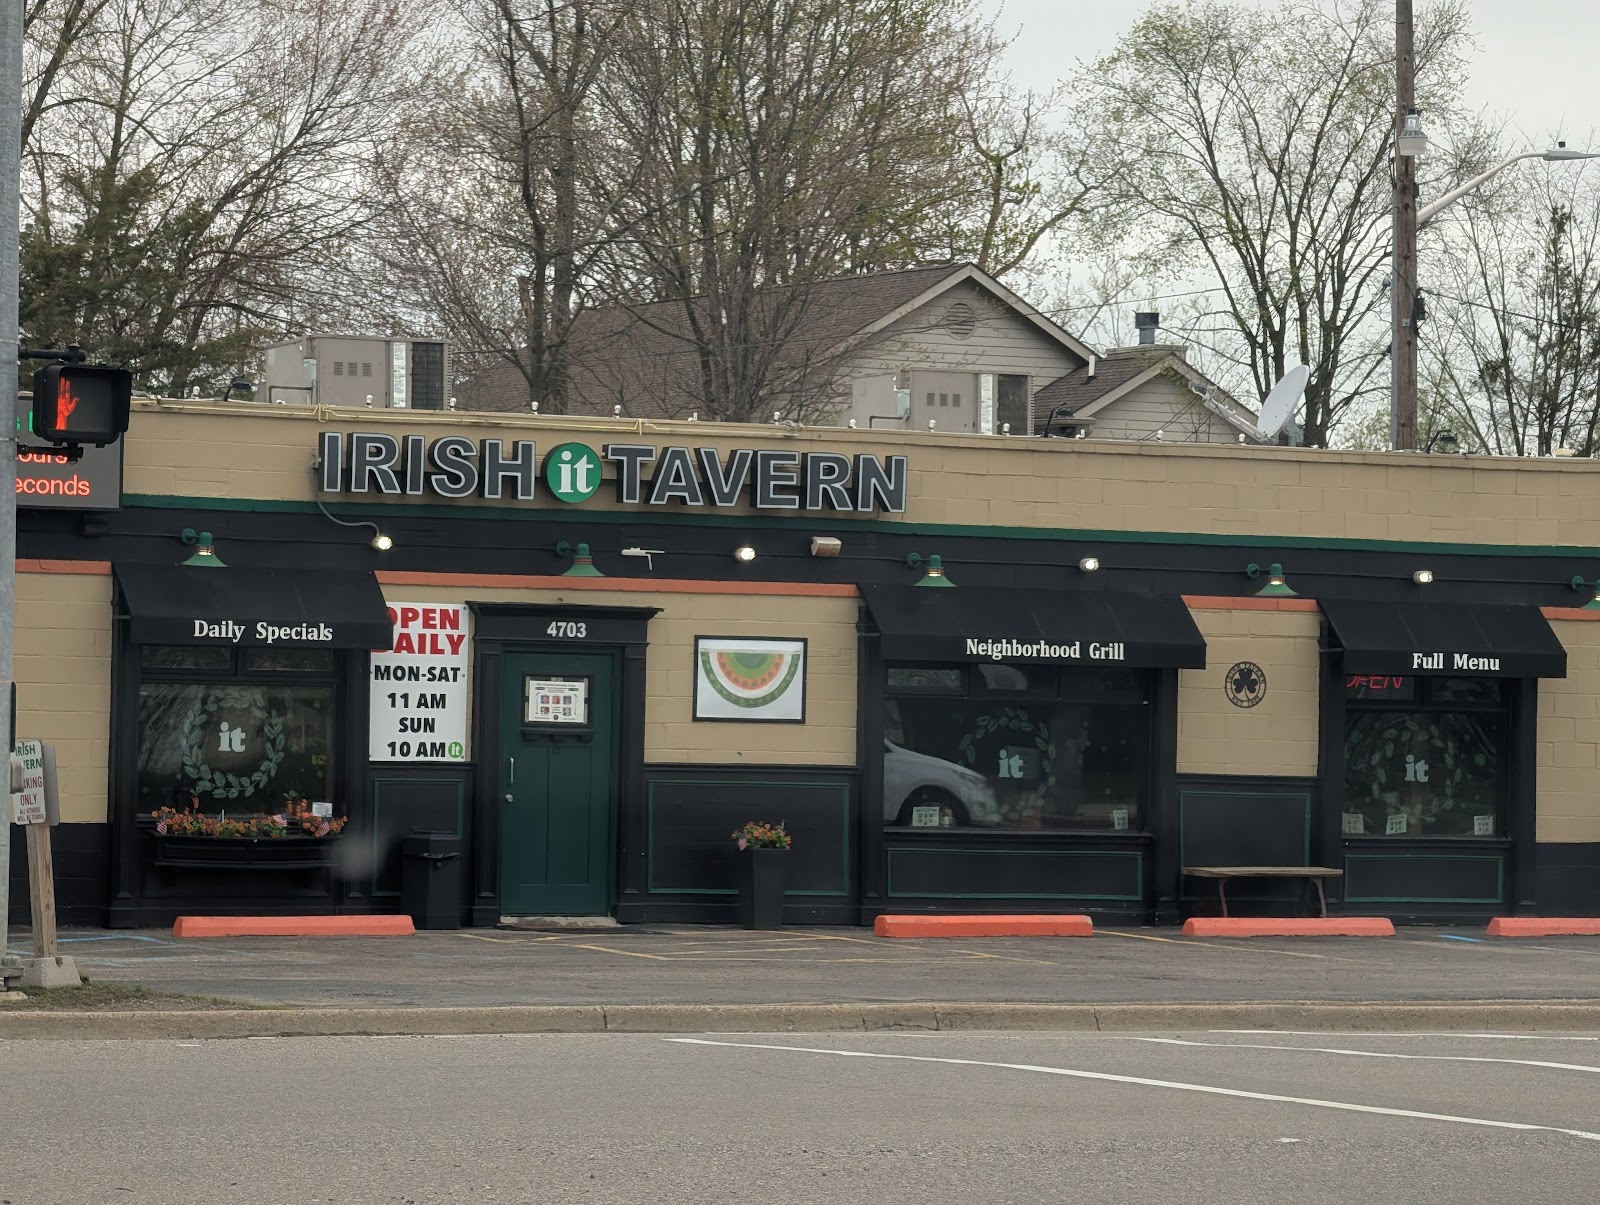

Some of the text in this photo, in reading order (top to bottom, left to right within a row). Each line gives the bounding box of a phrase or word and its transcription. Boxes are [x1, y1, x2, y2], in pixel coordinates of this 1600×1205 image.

[320, 432, 907, 512] IRISH it TAVERN
[193, 620, 333, 643] Daily Specials
[547, 621, 586, 638] 4703
[372, 632, 466, 656] AILY
[966, 638, 1125, 660] Neighborhood Grill
[1412, 653, 1500, 670] Full Menu
[374, 665, 461, 682] MON-SAT
[387, 692, 446, 709] 11 AM
[398, 717, 435, 733] SUN
[218, 721, 246, 753] it
[387, 741, 446, 758] 10 AM
[999, 749, 1023, 778] it
[1404, 754, 1430, 783] it
[20, 793, 37, 806] ONLY
